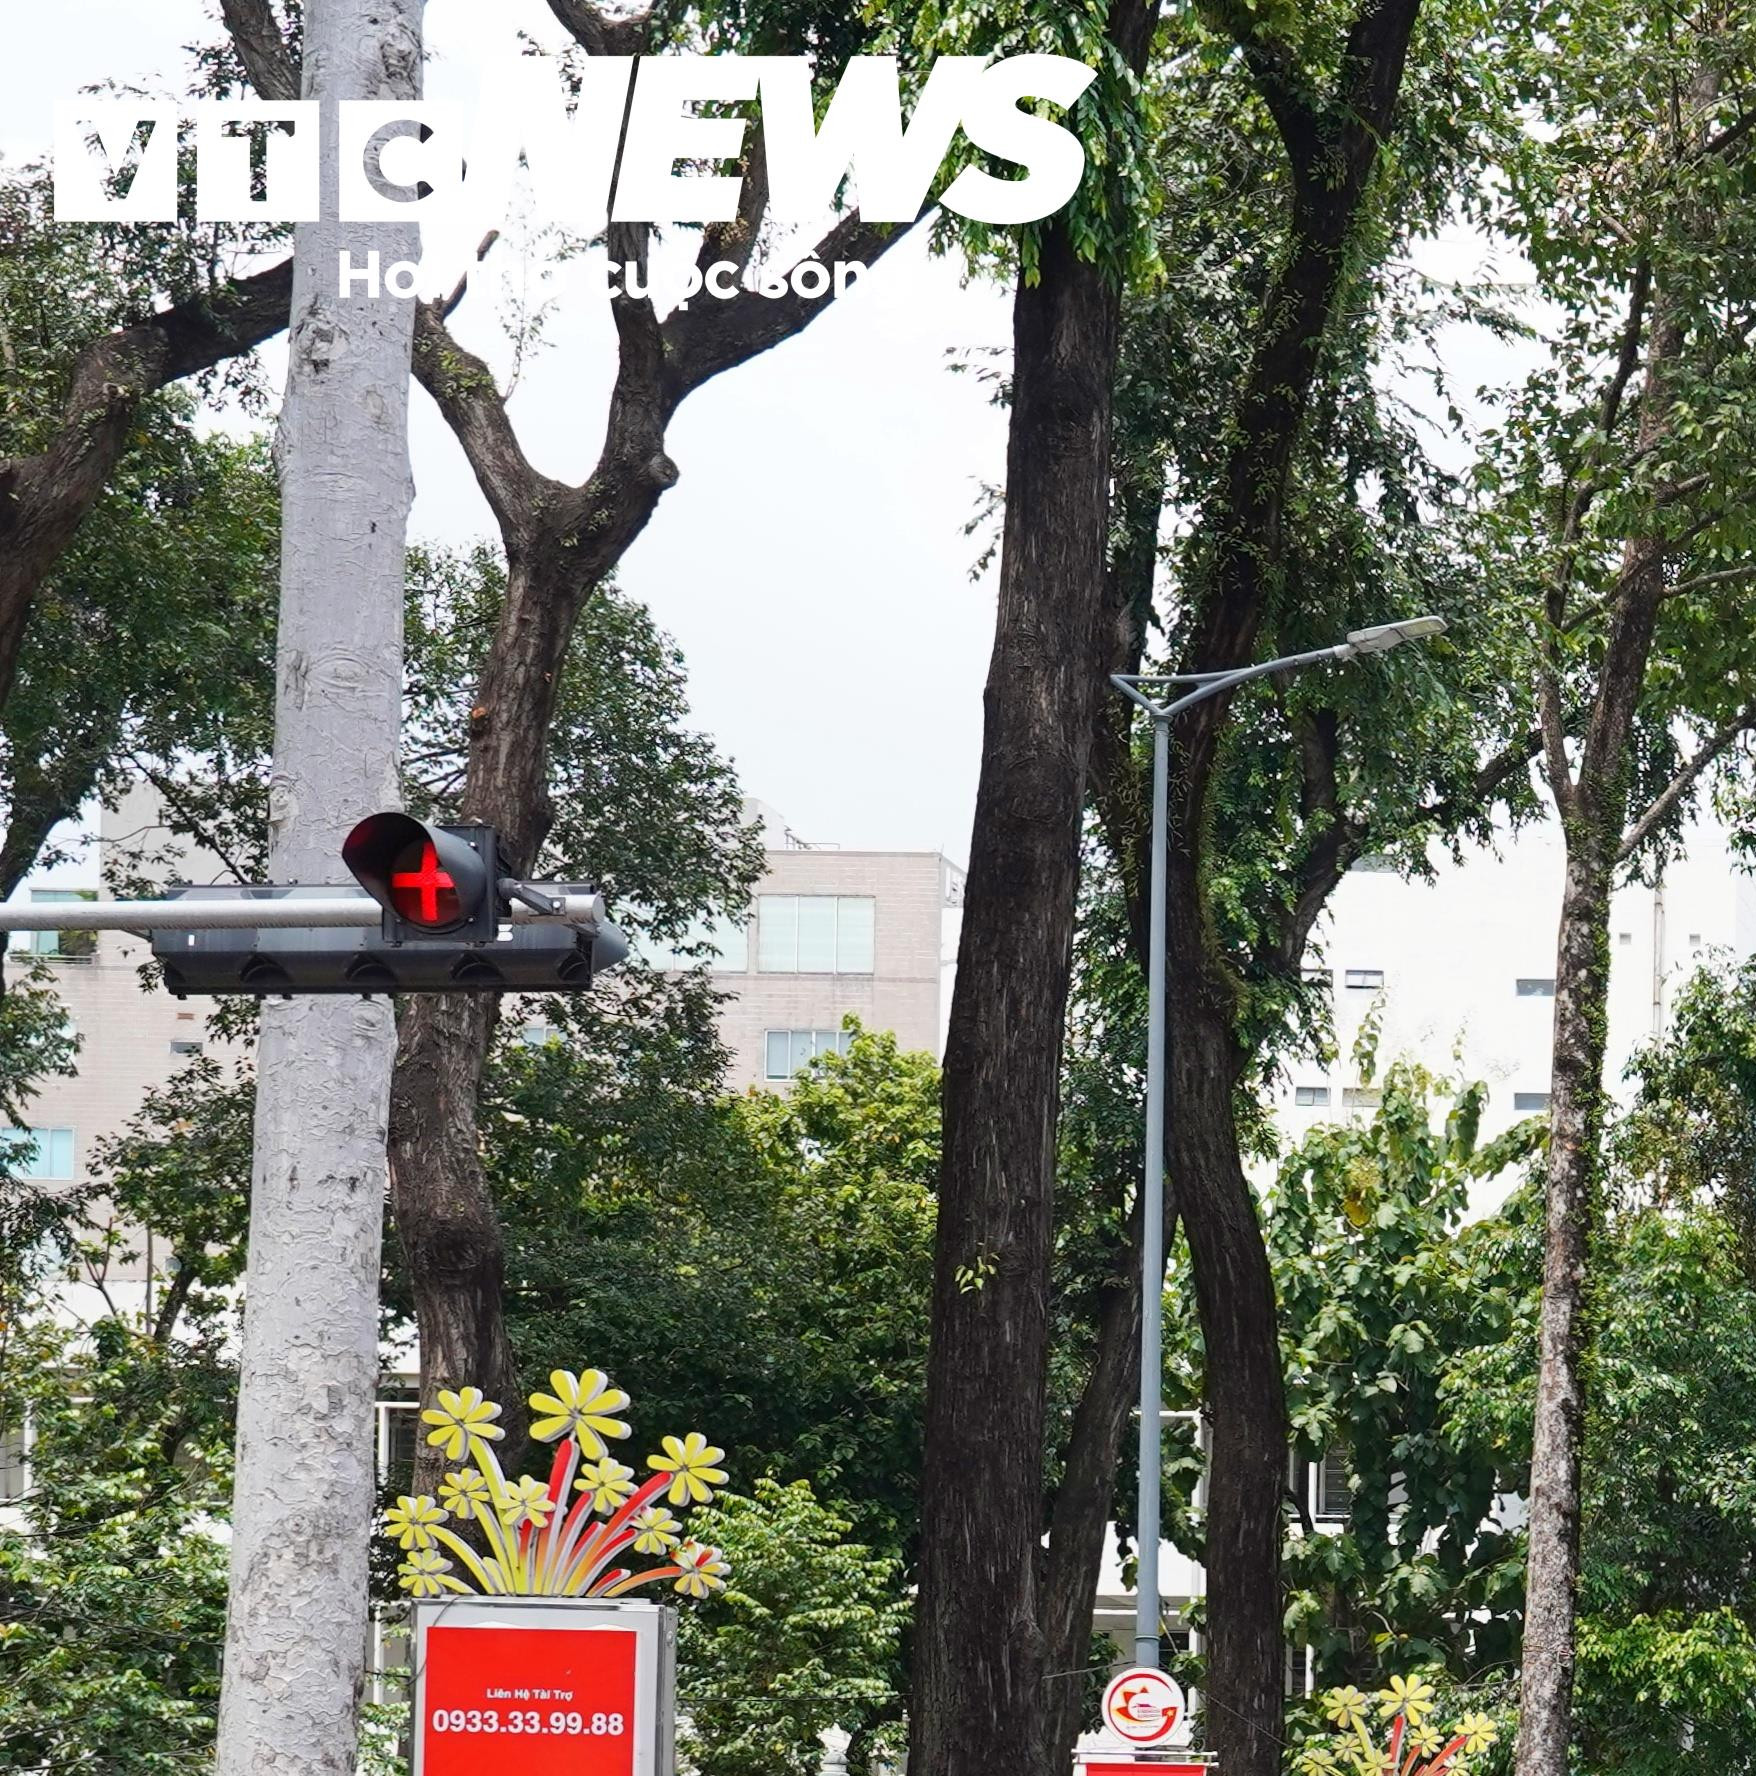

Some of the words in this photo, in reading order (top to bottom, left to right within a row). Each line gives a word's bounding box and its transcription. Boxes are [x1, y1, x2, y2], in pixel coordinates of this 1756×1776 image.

[487, 1688, 511, 1700] Liên
[515, 1688, 530, 1701] Hệ
[533, 1688, 550, 1700] Tài
[554, 1687, 573, 1701] Trợ
[432, 1709, 624, 1735] 0933.33.99.88
